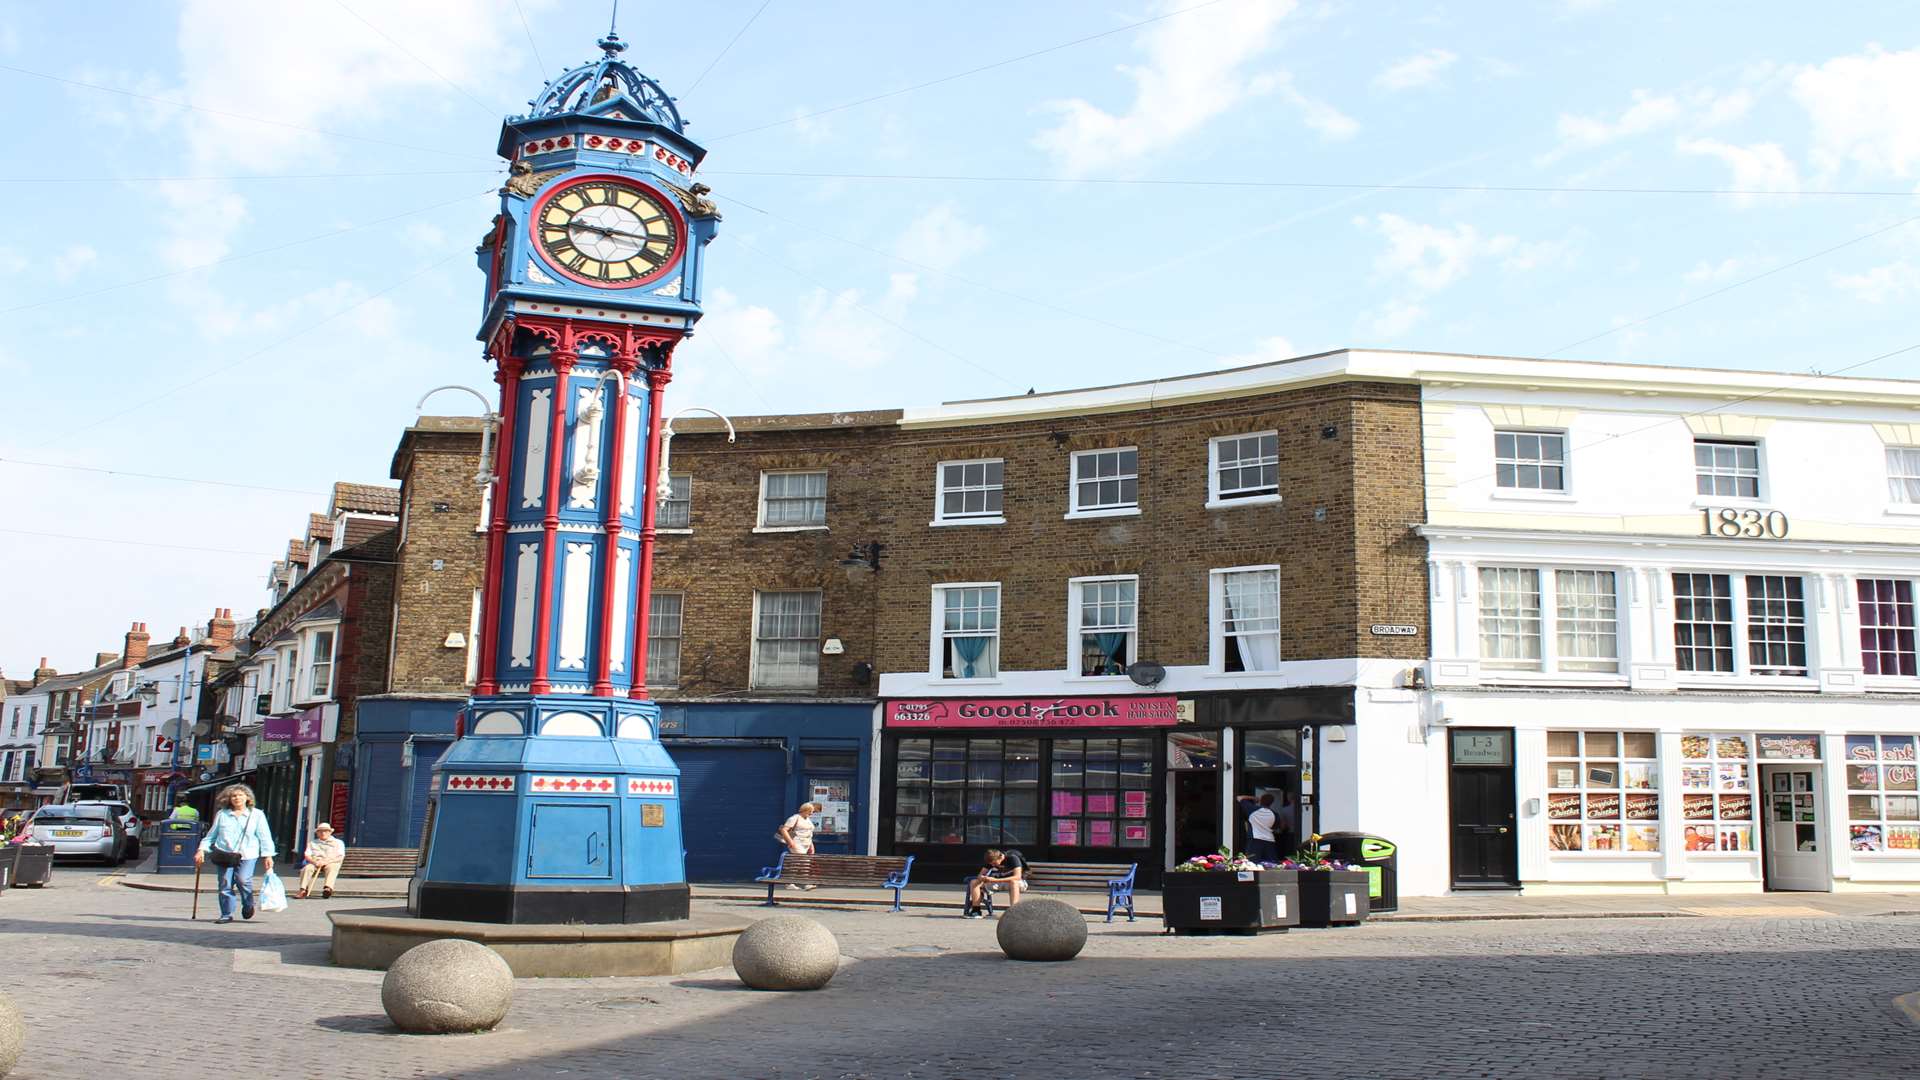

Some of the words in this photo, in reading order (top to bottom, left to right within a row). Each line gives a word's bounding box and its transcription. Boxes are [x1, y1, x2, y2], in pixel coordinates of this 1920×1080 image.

[1697, 507, 1789, 539] 1830
[958, 701, 1031, 719] Good
[1051, 700, 1119, 718] Look
[1129, 702, 1173, 710] UNISEX
[894, 712, 930, 721] 663326
[1127, 710, 1146, 719] HAIR
[1148, 710, 1176, 720] SALON
[266, 732, 292, 740] Scope
